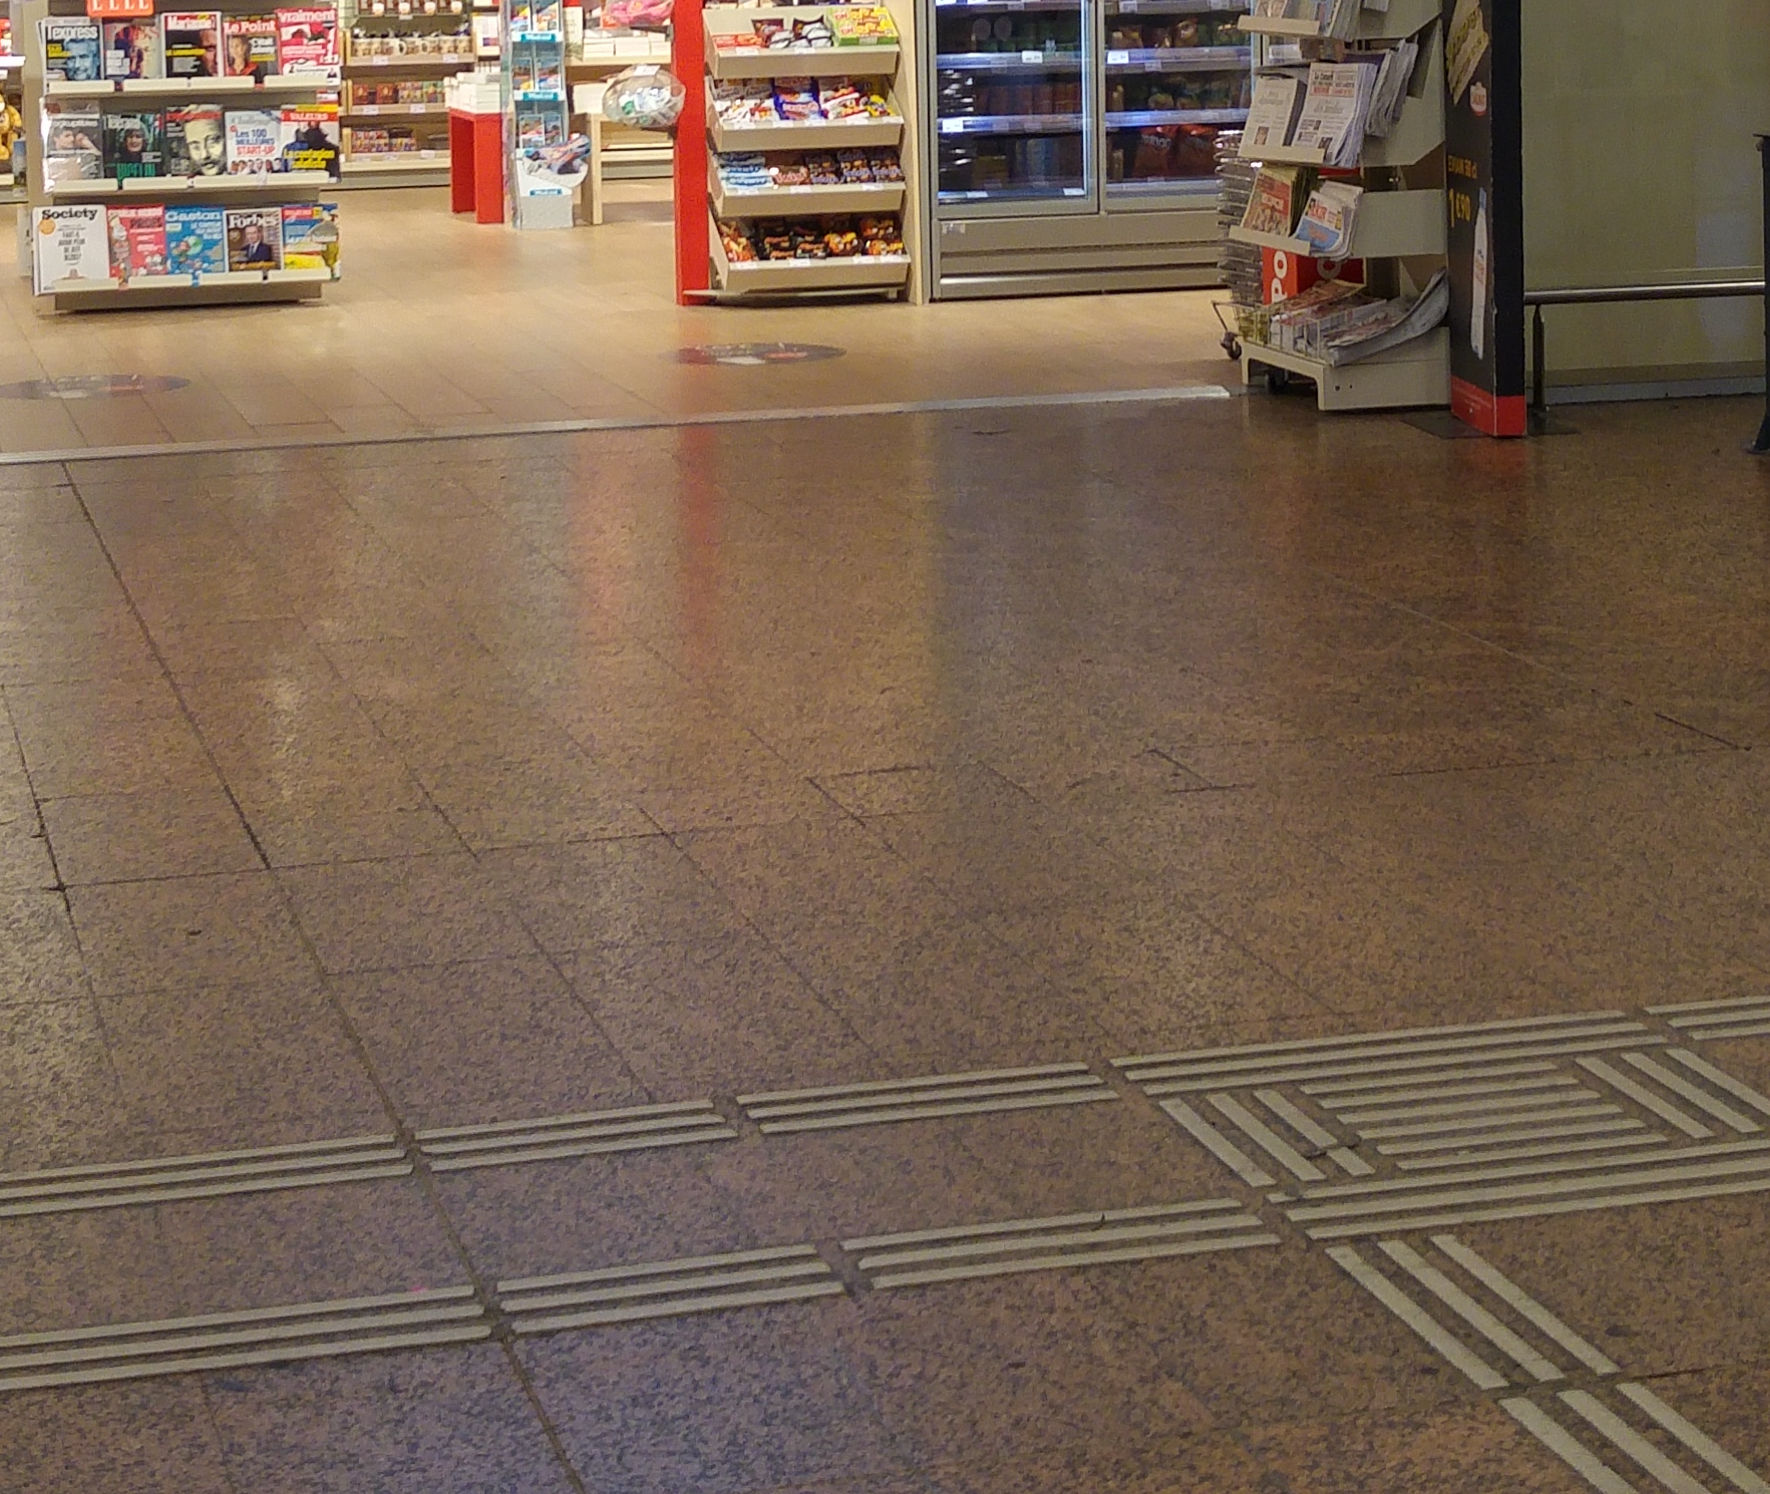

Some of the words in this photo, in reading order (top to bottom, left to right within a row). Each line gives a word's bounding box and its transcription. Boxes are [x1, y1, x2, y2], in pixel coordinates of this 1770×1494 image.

[223, 21, 240, 35] Le
[241, 20, 277, 33] Point
[41, 207, 98, 221] Society
[165, 210, 221, 222] Gaston
[229, 213, 280, 229] Forbes
